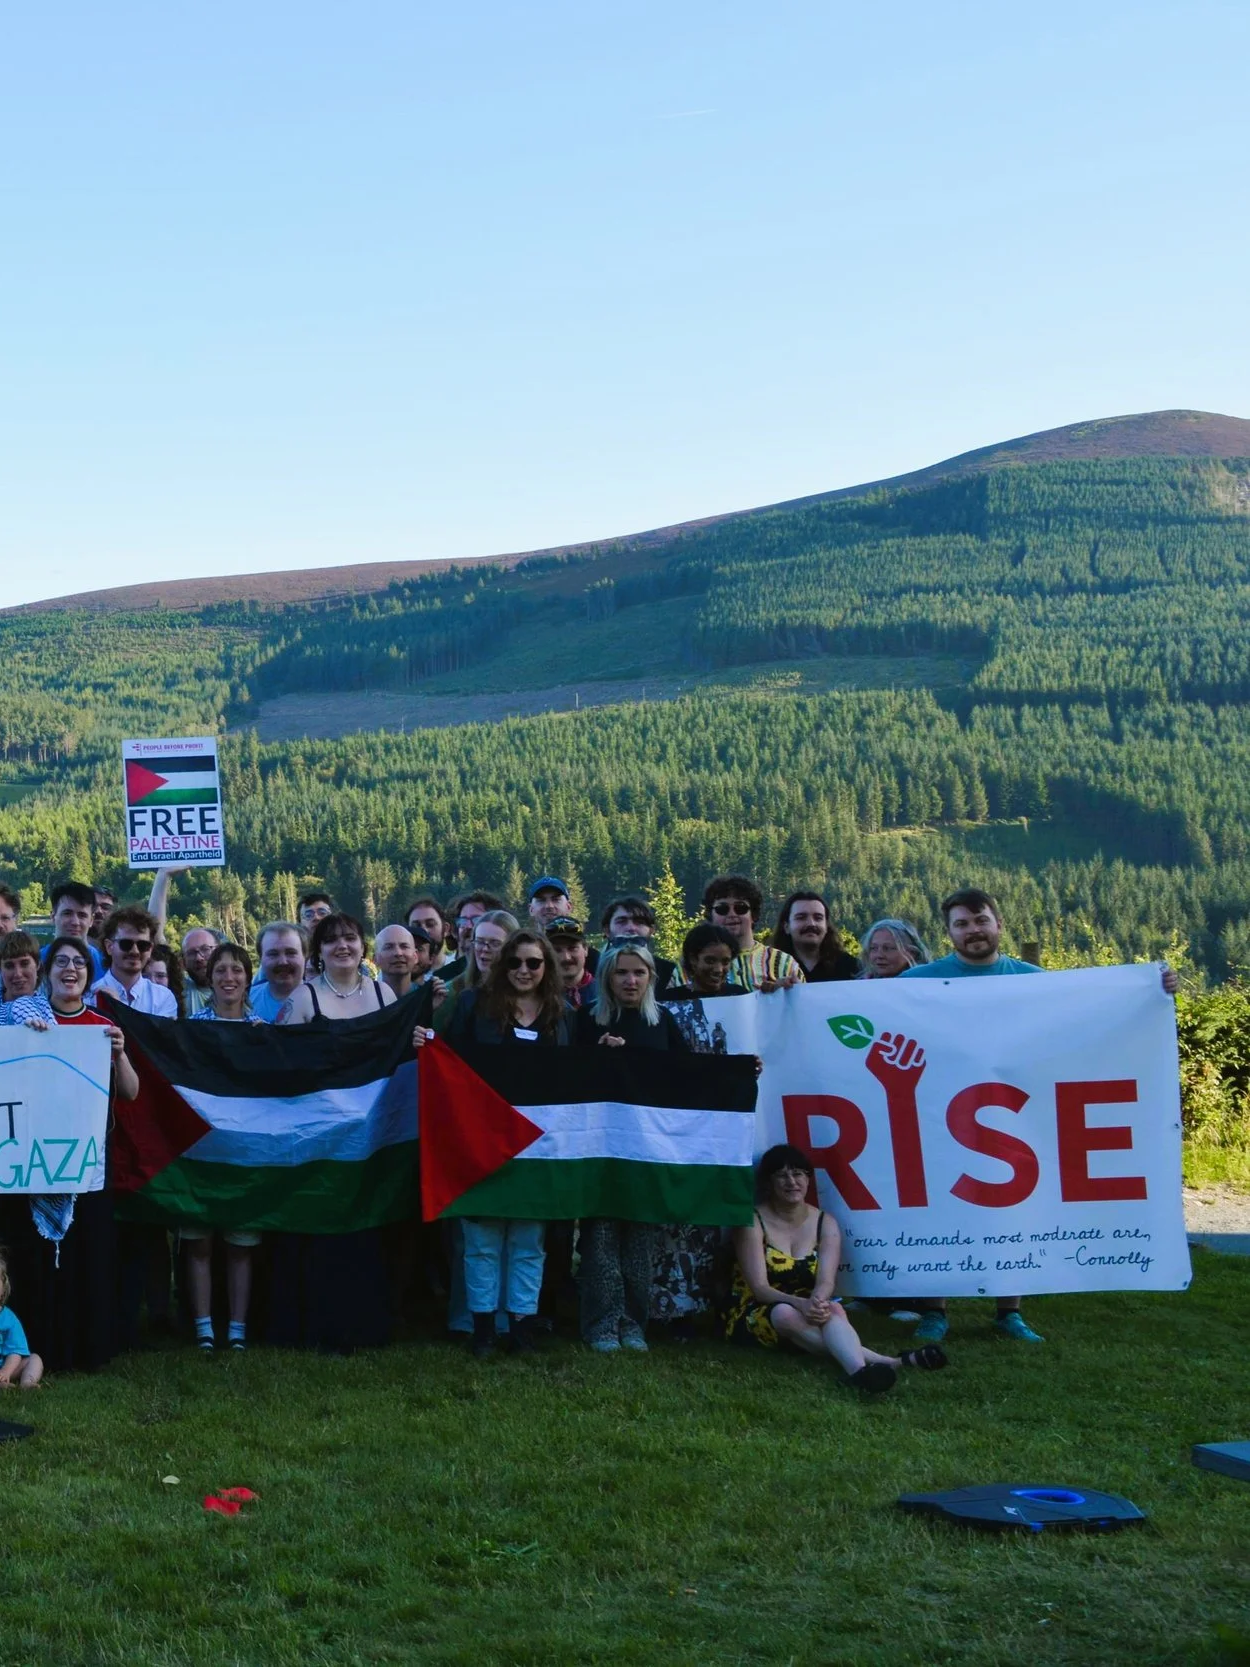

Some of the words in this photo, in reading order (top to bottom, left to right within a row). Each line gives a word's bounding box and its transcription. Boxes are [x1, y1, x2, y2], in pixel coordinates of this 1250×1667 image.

[129, 806, 219, 837] FREE
[130, 835, 221, 851] PALESTINE
[132, 852, 149, 861] End
[150, 851, 177, 860] Israeli
[178, 849, 221, 860] Apartheid
[781, 1032, 1148, 1211] RISE
[895, 1229, 975, 1247] demands
[983, 1231, 1024, 1244] most
[1030, 1225, 1105, 1242] moderate
[862, 1260, 900, 1281] only
[907, 1260, 953, 1272] want
[957, 1254, 988, 1272] the
